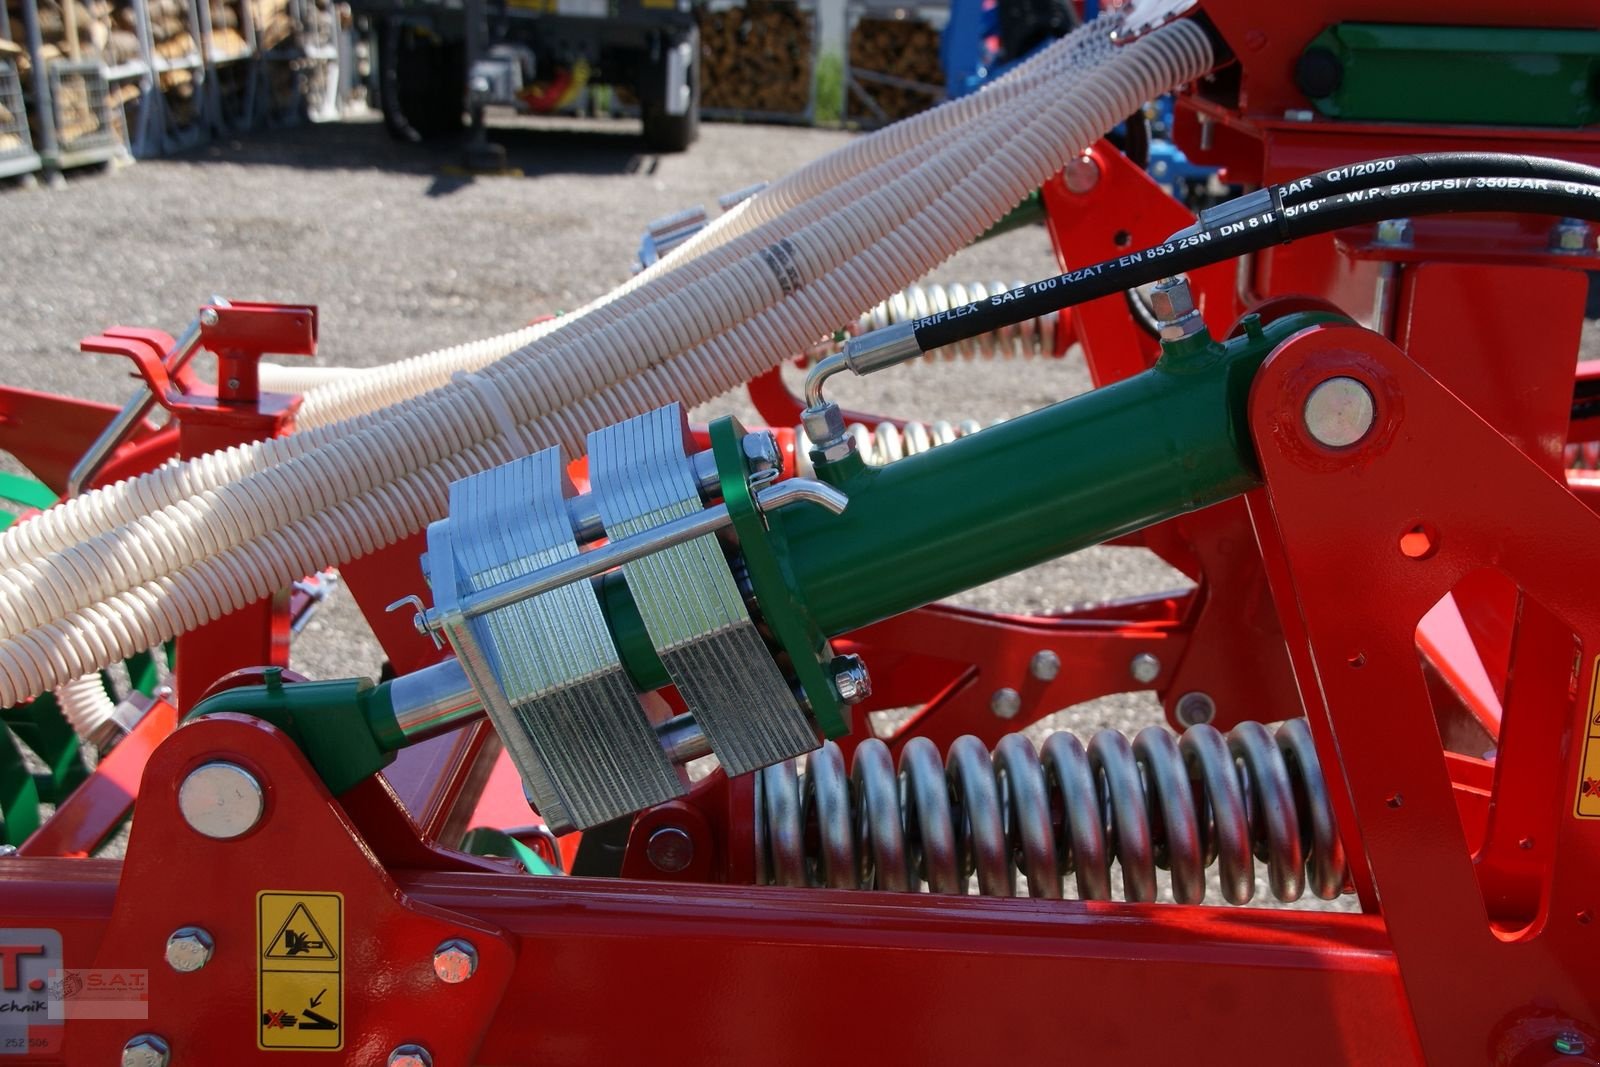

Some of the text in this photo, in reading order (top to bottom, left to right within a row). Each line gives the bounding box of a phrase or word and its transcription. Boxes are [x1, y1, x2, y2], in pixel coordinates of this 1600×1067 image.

[1327, 159, 1396, 182] Q1/2020
[991, 287, 1026, 306] SAE
[1030, 278, 1057, 294] 100
[1061, 264, 1104, 285] R2AT
[1119, 253, 1143, 268] EN
[1146, 243, 1175, 259] 853
[1179, 231, 1212, 249] 2SN
[1219, 221, 1245, 237] DN
[1249, 217, 1259, 228] 8
[1345, 187, 1386, 203] W.P.
[1390, 178, 1461, 195] 5075PSI
[1464, 178, 1471, 189] /
[1475, 178, 1549, 190] 350BAR
[5, 1038, 25, 1048] 252
